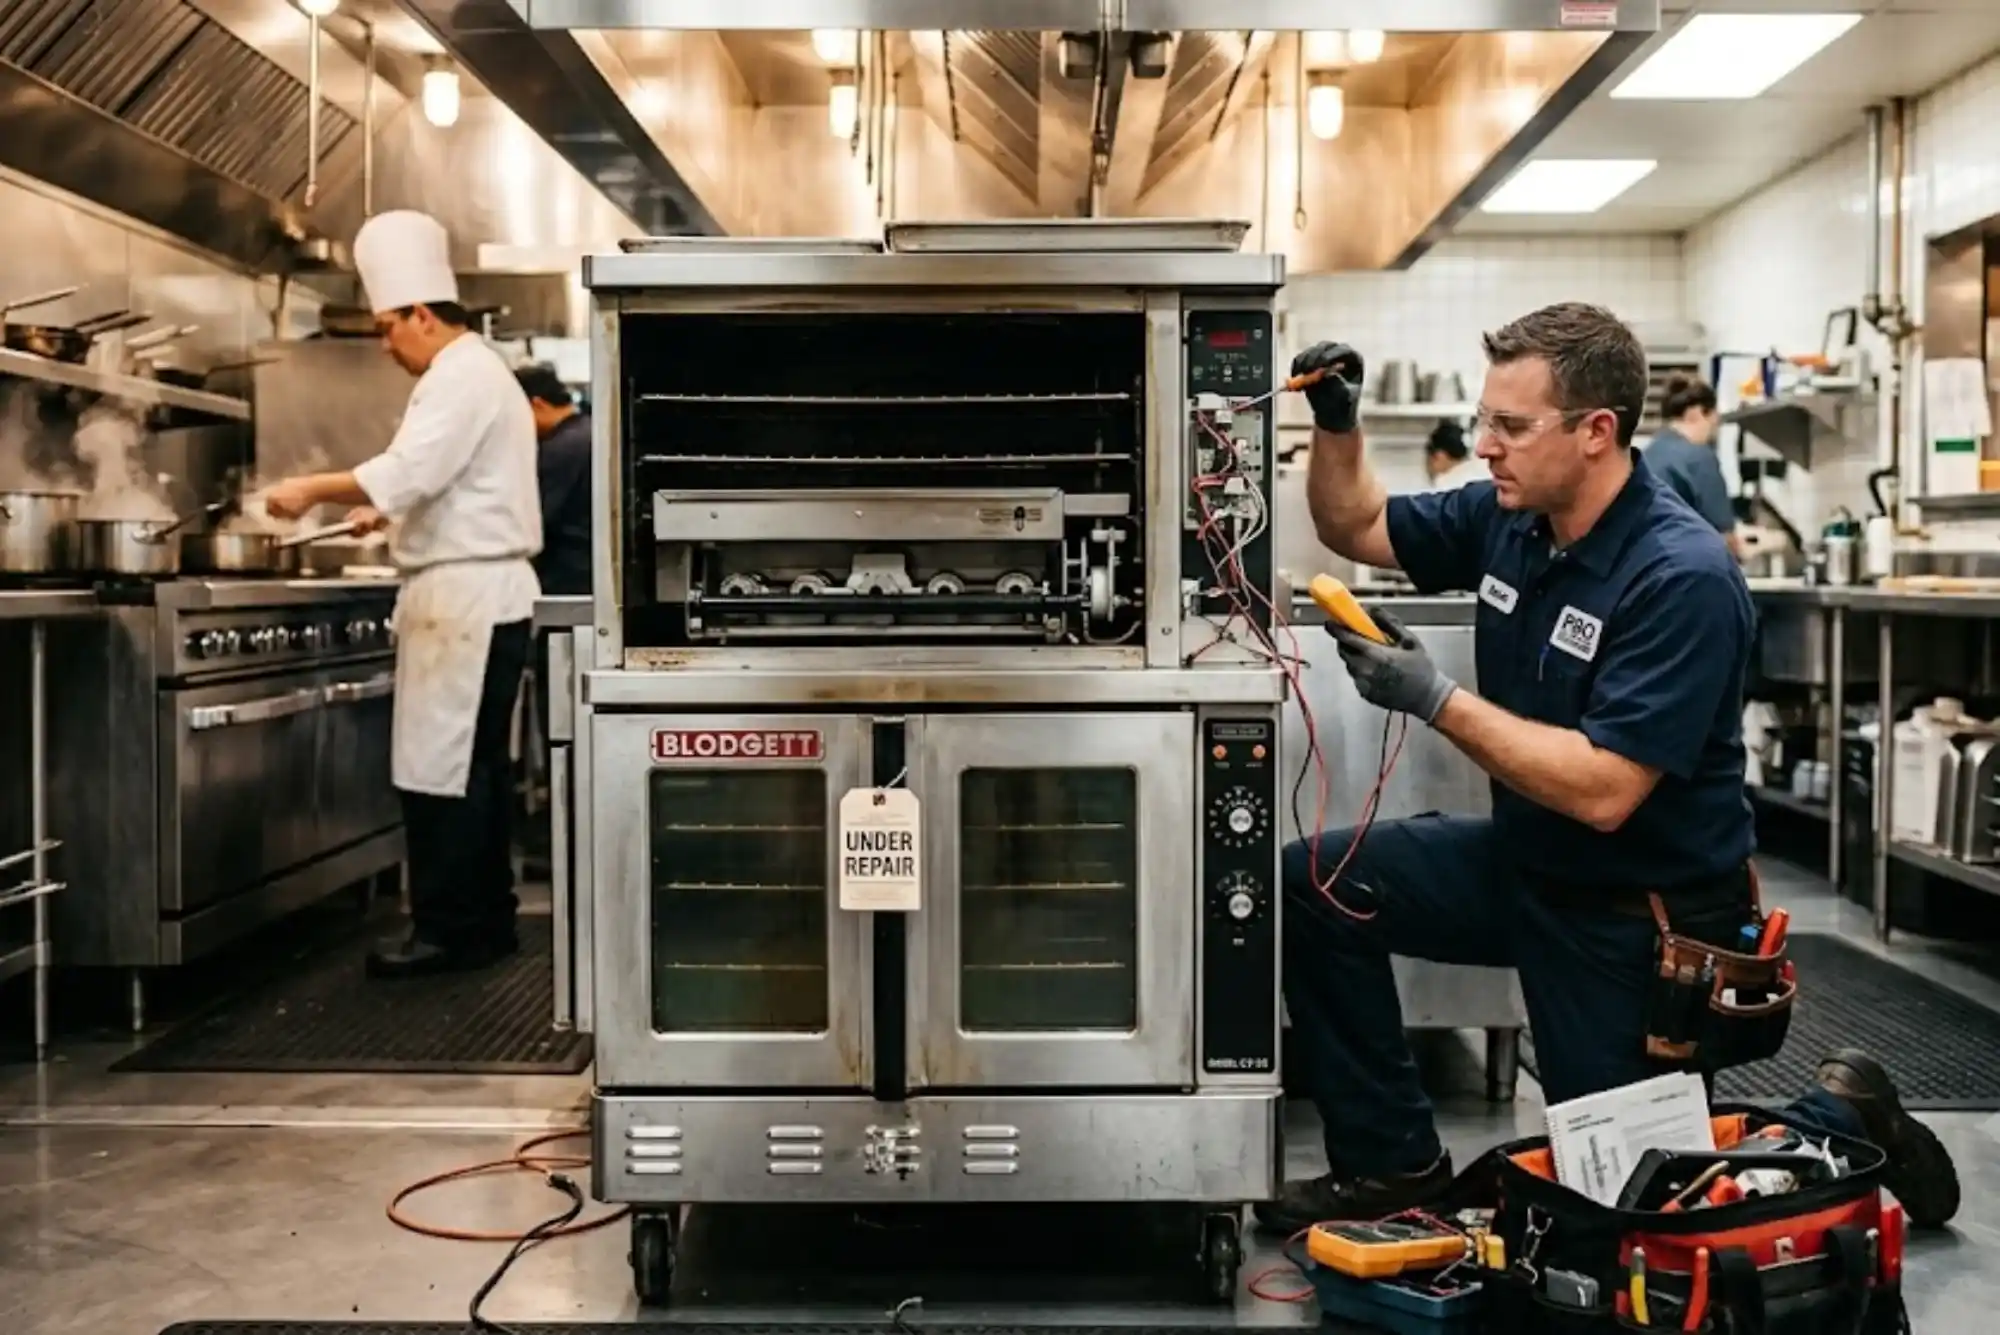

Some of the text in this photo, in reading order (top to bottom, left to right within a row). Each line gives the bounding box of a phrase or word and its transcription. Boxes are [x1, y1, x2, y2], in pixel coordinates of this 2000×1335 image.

[662, 733, 814, 756] BLODGETT
[846, 830, 913, 851] UNDER
[845, 856, 915, 876] REPAIR
